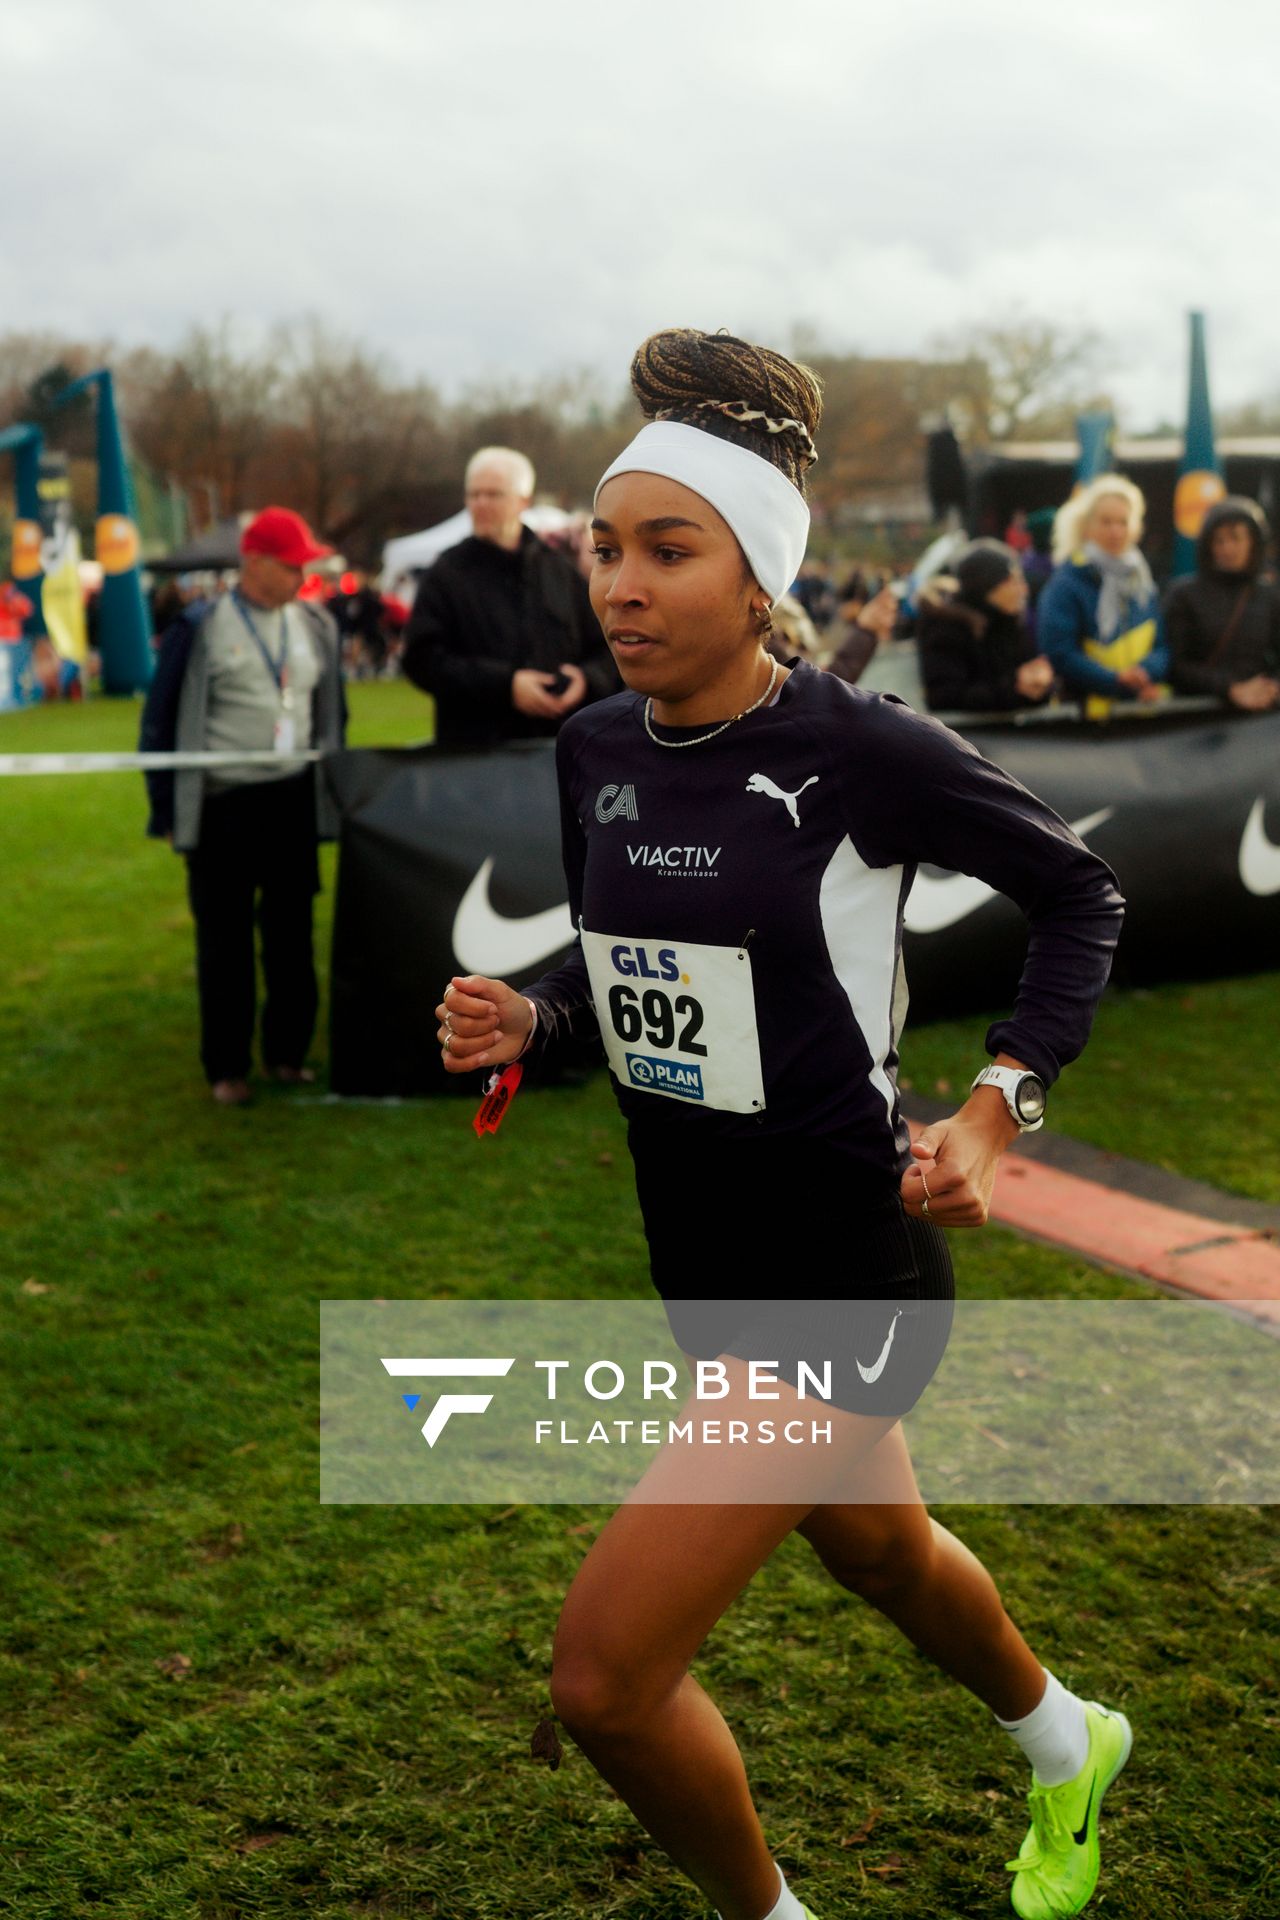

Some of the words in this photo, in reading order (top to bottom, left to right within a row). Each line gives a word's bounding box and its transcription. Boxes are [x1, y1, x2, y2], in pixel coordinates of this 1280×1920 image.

[626, 845, 722, 867] VIACTIV
[657, 869, 719, 878] Krankenkasse
[608, 984, 708, 1058] 692
[656, 1064, 699, 1088] PLAN
[658, 1081, 701, 1096] INTERNATIONAL
